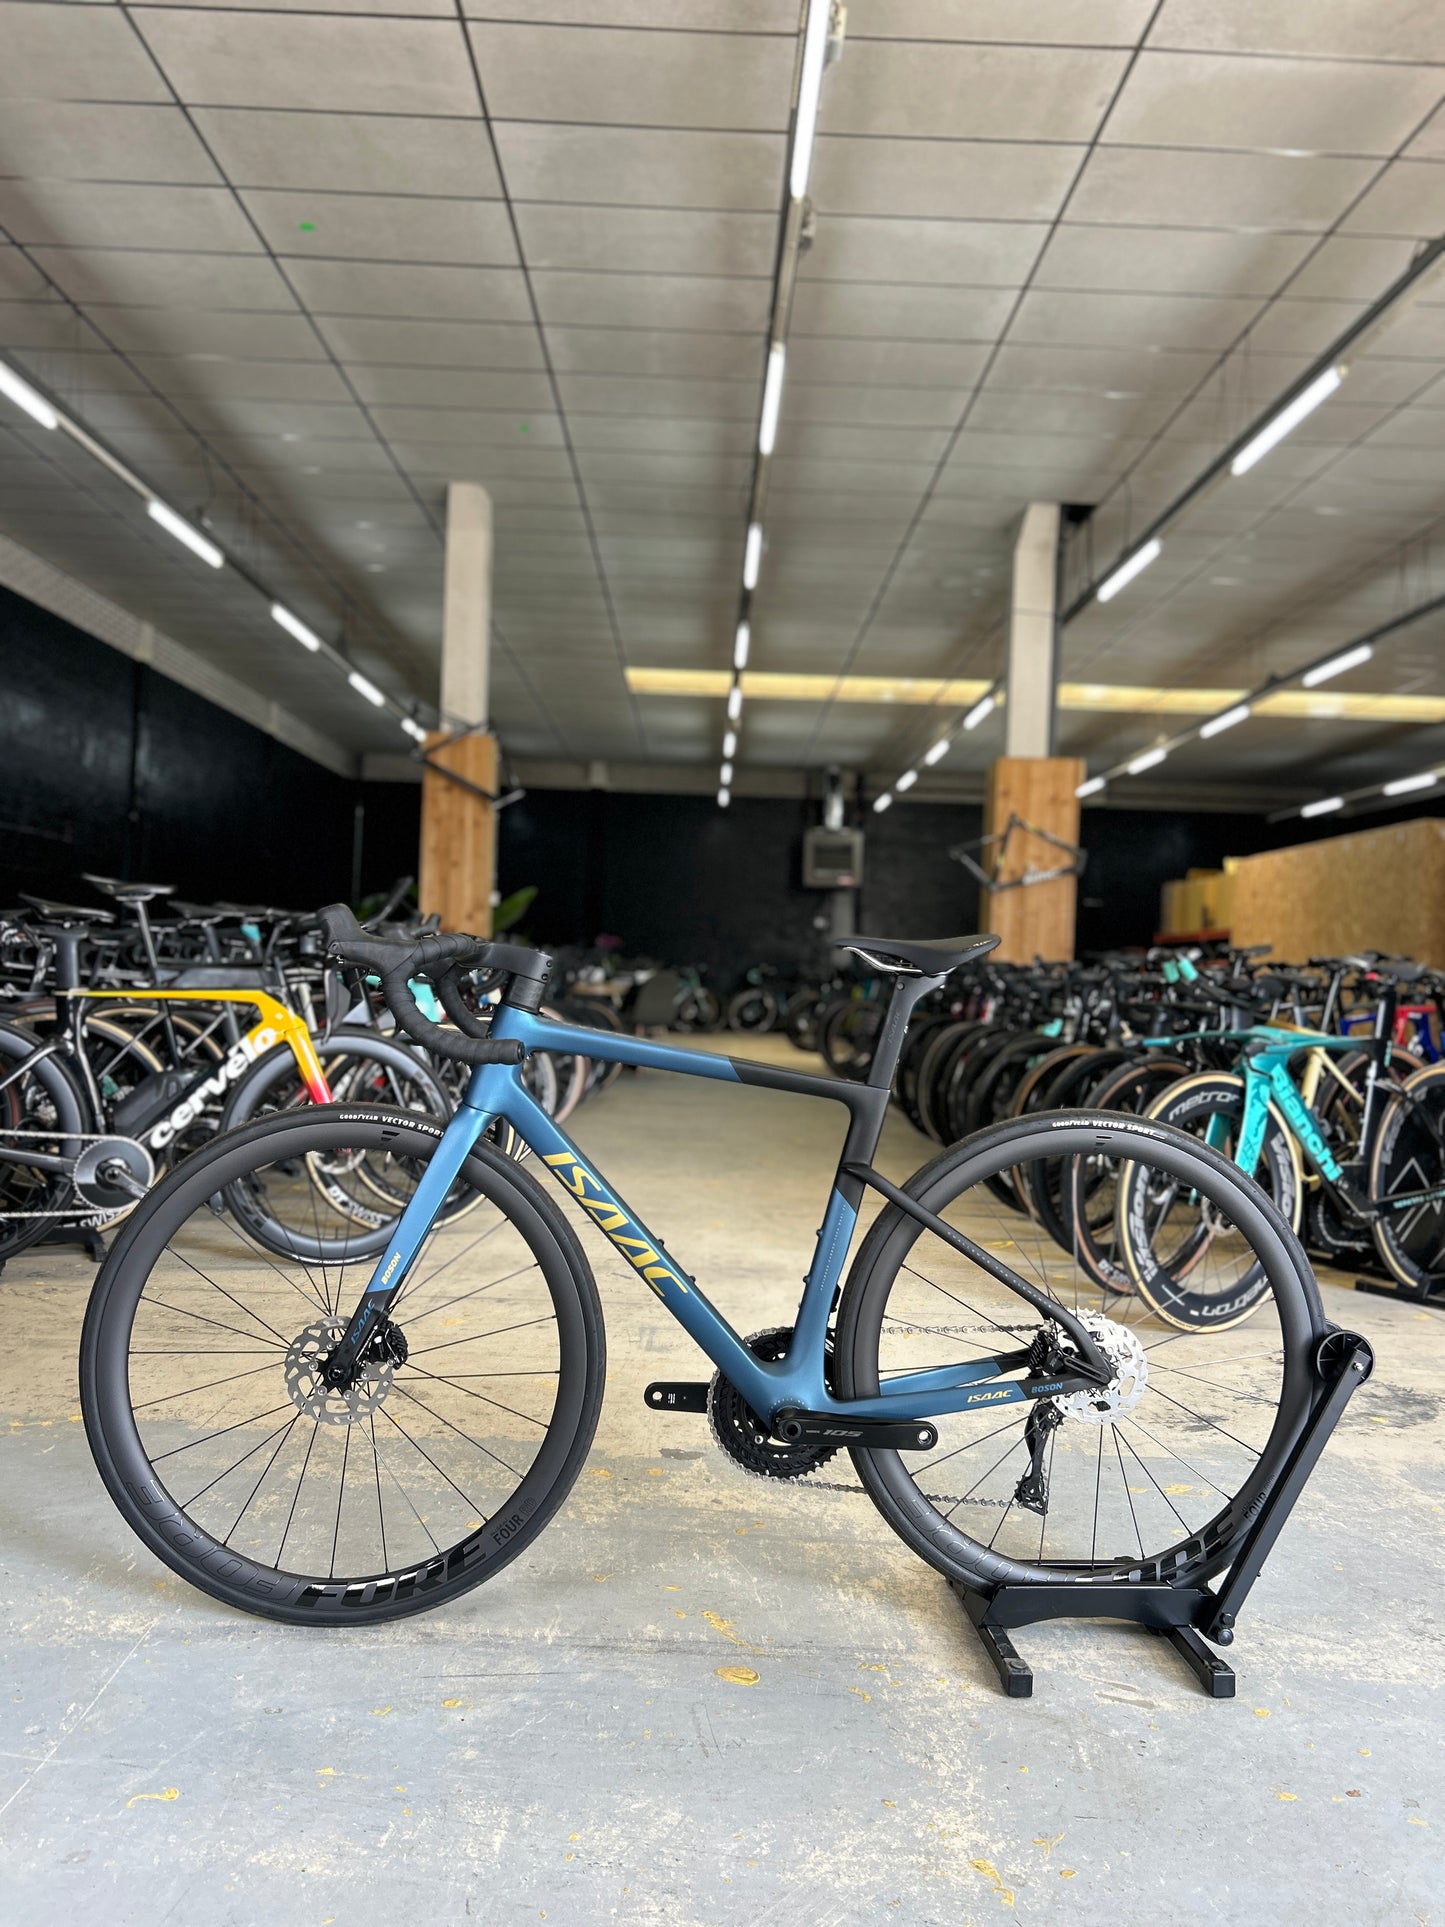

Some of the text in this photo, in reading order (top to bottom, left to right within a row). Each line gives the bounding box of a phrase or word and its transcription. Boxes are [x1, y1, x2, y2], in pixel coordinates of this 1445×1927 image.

[381, 1115, 416, 1129] VECTOR
[1092, 1119, 1126, 1130] VECTOR
[1126, 1123, 1154, 1136] SPORT
[1270, 1063, 1344, 1182] Bianchi
[542, 1151, 688, 1297] ISAAC
[381, 1251, 402, 1285] BOSON
[350, 1298, 376, 1345] ISAAC
[967, 1382, 1064, 1403] ISAAC BOSON
[823, 1429, 864, 1438] 105
[493, 1514, 524, 1546] FOUR
[293, 1528, 487, 1608] FORE
